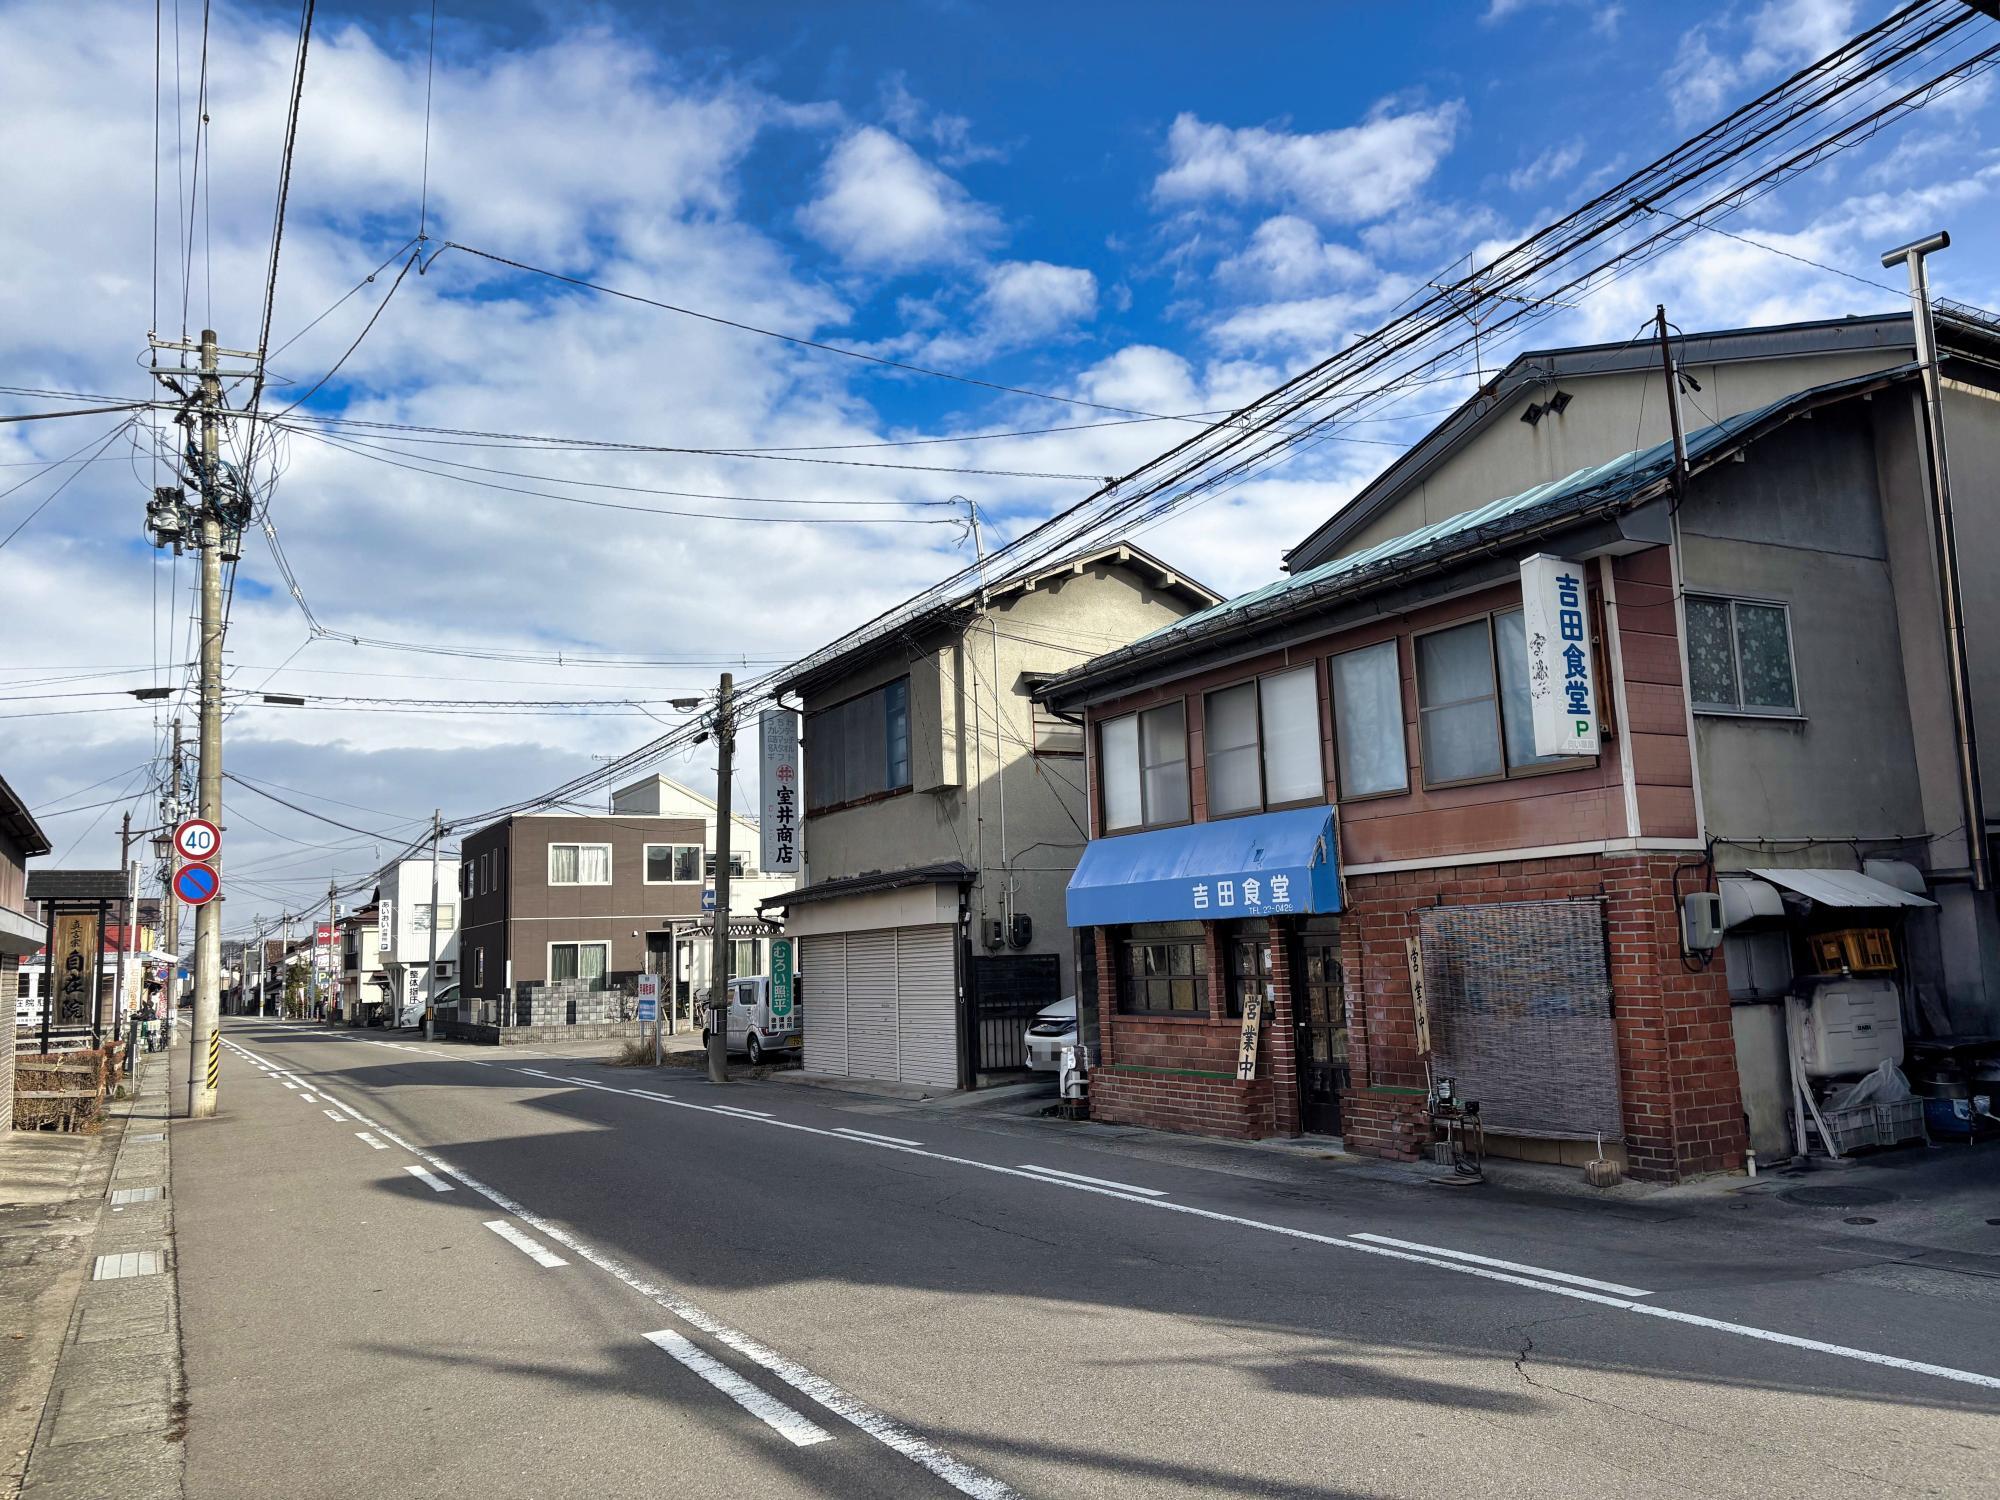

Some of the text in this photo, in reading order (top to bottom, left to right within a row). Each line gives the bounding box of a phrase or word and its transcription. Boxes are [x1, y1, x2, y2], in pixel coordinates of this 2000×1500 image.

[1555, 573, 1591, 715] 吉田食堂
[1576, 720, 1589, 738] P
[185, 831, 211, 849] 40
[776, 786, 795, 864] 室井商店
[1192, 874, 1291, 910] 吉田食堂
[61, 919, 86, 1020] 真言宗 自在院
[773, 946, 787, 1012] むろい照平
[1410, 946, 1426, 1032] 営業中
[1239, 997, 1261, 1078] 営業中
